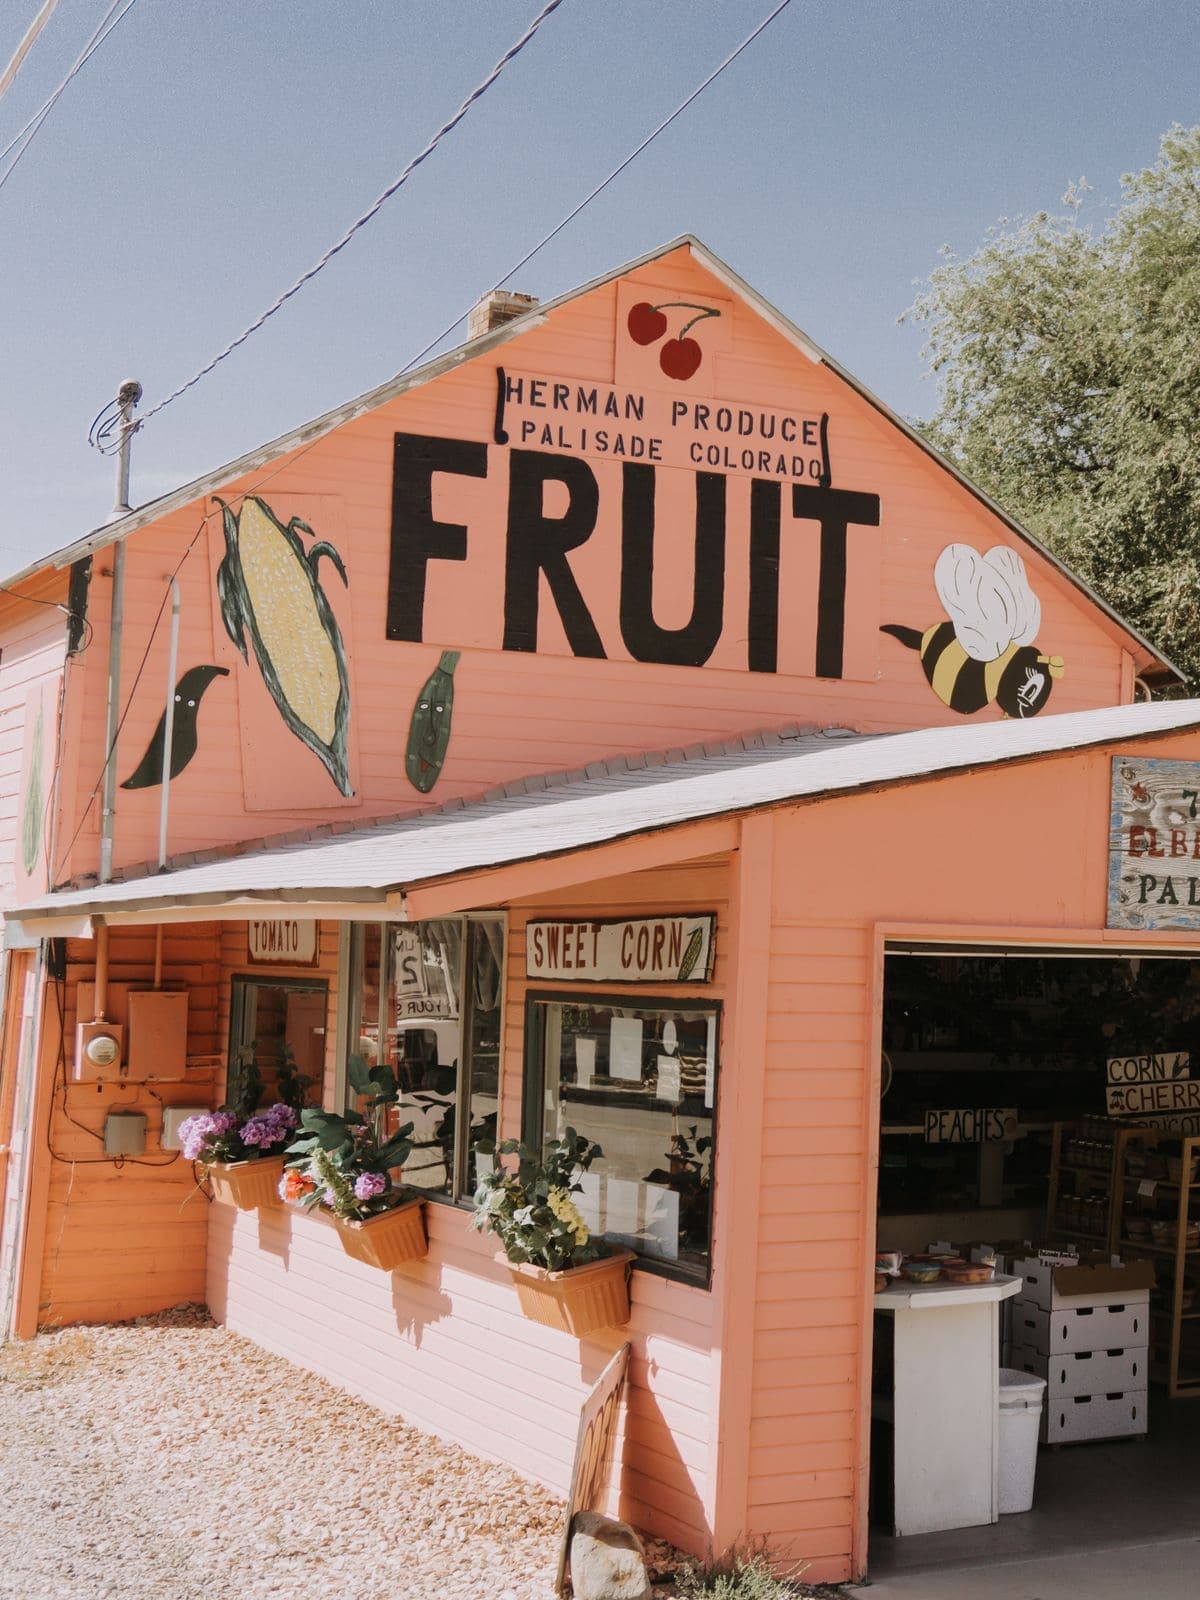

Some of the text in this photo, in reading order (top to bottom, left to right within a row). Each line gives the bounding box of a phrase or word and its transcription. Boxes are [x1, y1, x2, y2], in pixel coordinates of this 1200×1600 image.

[505, 376, 819, 446] HERMAN PRODUCE
[521, 420, 823, 480] PALISADE COLORADO
[386, 432, 880, 680] FRUIT
[254, 920, 298, 952] TOMATO
[533, 921, 683, 971] SWEET CORN
[1109, 1057, 1166, 1082] CORN
[926, 1109, 1005, 1143] PEACHES
